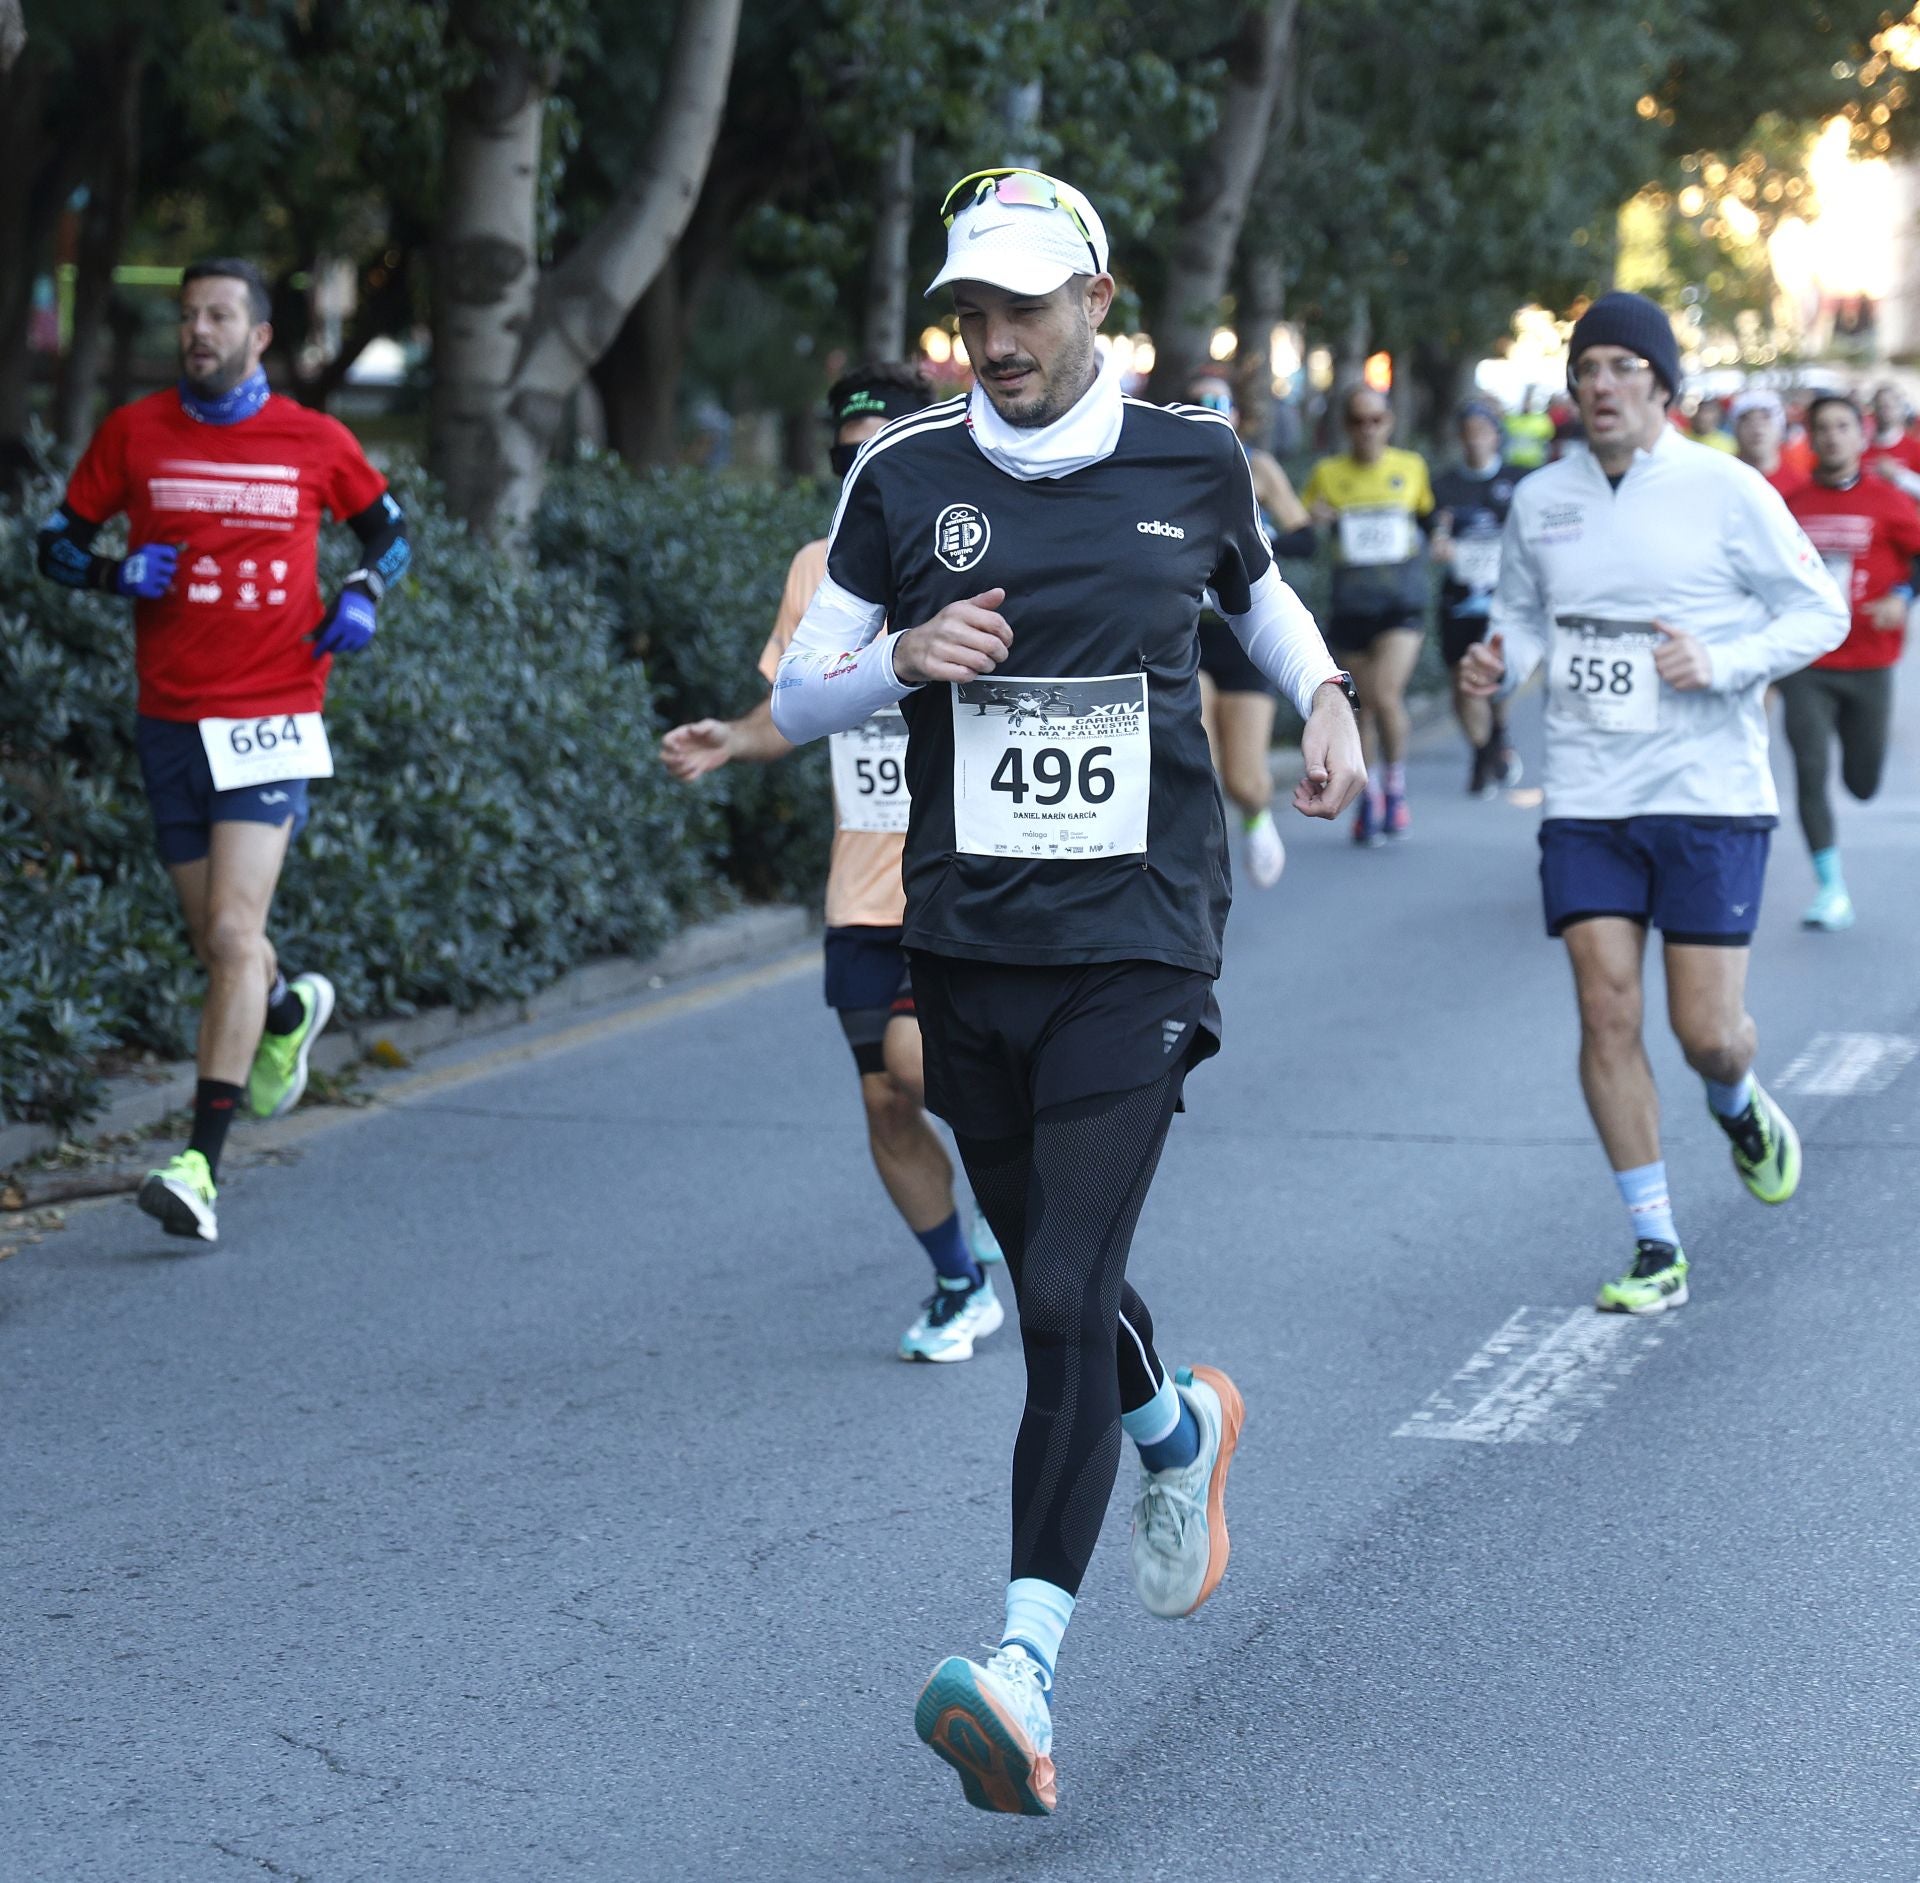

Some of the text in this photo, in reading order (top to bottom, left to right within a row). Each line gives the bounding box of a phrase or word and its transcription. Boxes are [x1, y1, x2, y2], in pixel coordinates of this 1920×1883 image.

[1136, 520, 1185, 540] adidas
[950, 547, 974, 557] POSITIVO
[1568, 656, 1633, 695] 558
[1085, 701, 1143, 717] XIV
[1071, 720, 1140, 731] SILVESTRE
[1075, 714, 1140, 725] CARRERA
[230, 713, 302, 755] 664
[1067, 726, 1140, 736] PALMILLA
[856, 759, 901, 795] 59
[990, 746, 1115, 806] 496
[1041, 812, 1066, 820] MARÍN
[1067, 810, 1097, 819] GARCÍA
